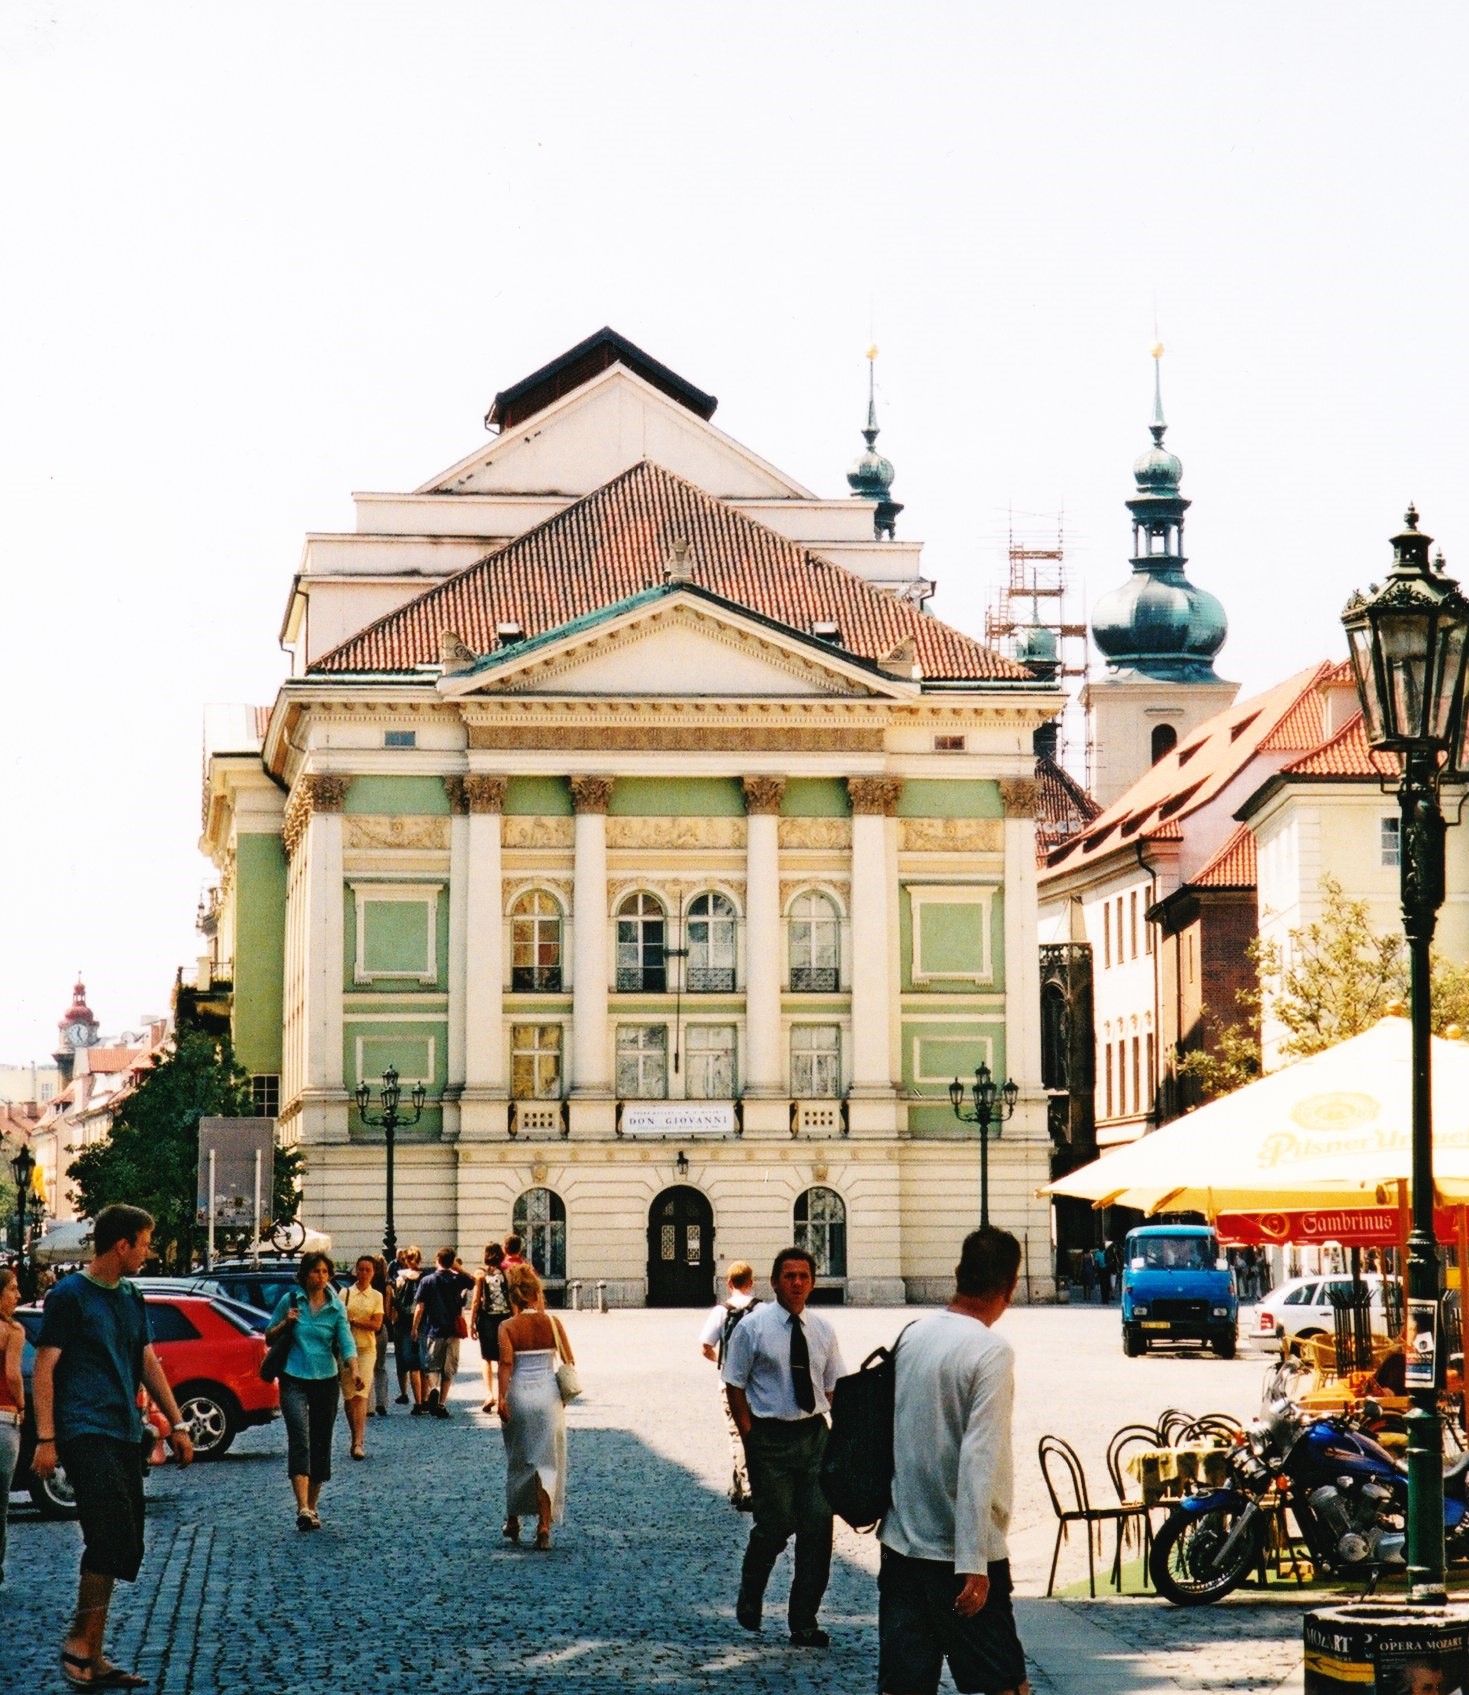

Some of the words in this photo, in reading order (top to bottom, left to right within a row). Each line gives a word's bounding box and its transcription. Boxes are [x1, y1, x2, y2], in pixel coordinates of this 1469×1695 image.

[629, 1117, 655, 1126] DON
[665, 1115, 728, 1125] GIOVANNI
[1257, 1131, 1372, 1168] Pilsner
[1302, 1213, 1393, 1234] Gambrinus
[1379, 1641, 1422, 1651] OPERA
[1426, 1636, 1463, 1649] MOZART
